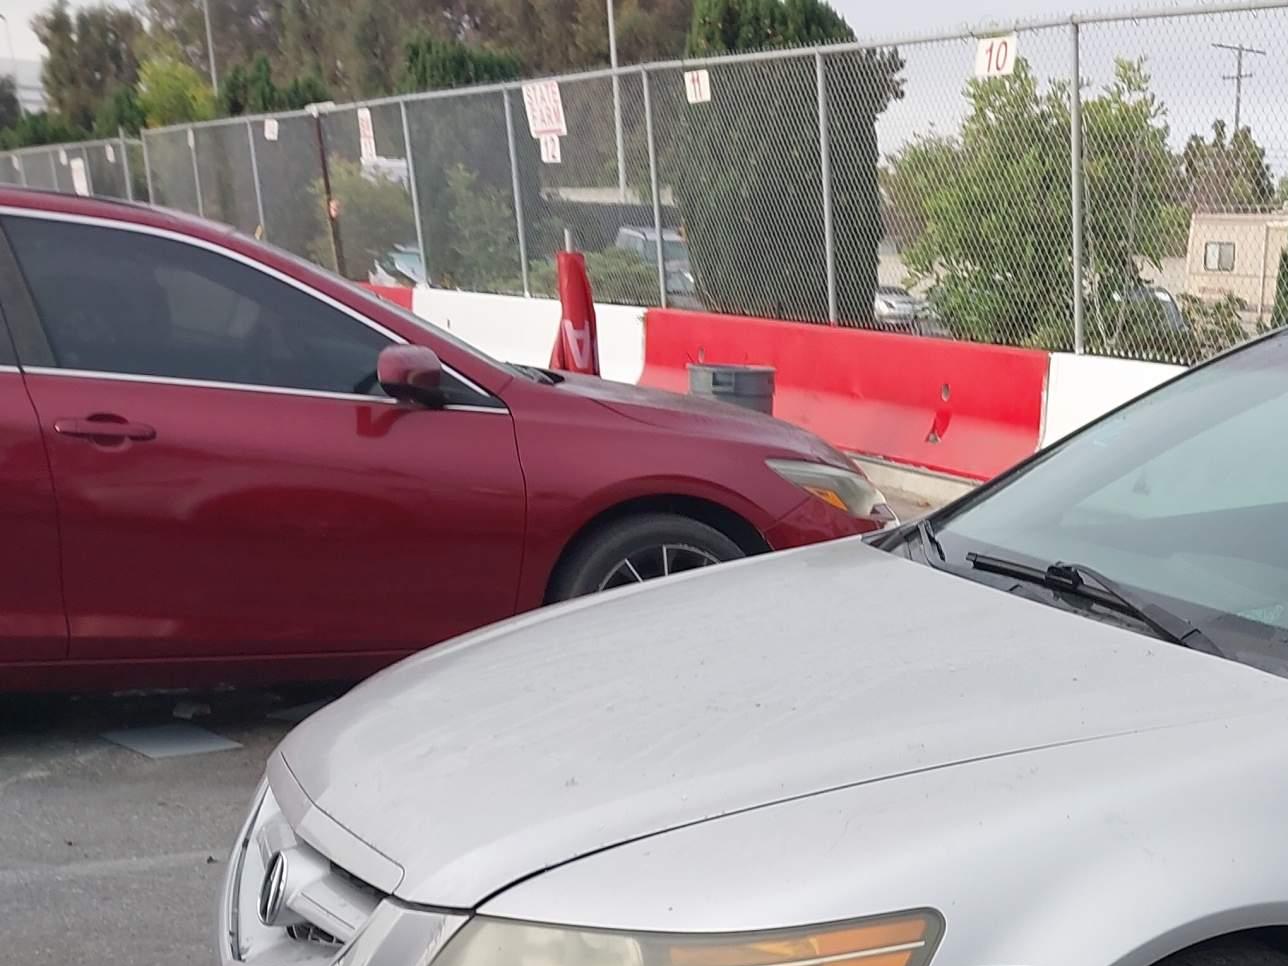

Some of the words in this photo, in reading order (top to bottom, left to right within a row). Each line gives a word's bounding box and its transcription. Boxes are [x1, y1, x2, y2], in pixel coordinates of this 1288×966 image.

[986, 40, 1008, 72] 10
[525, 82, 559, 105] STATE
[543, 137, 557, 159] 12
